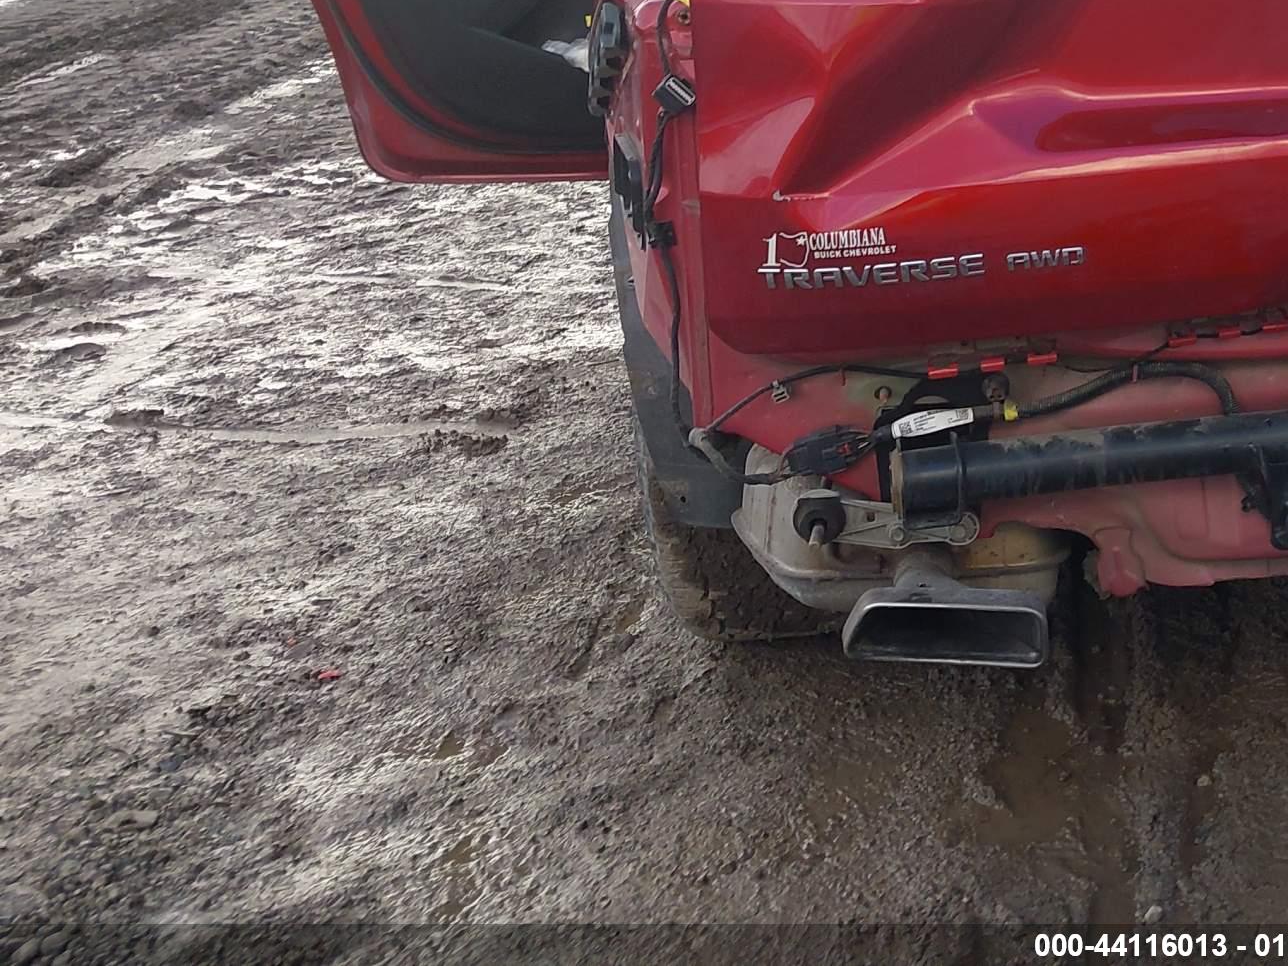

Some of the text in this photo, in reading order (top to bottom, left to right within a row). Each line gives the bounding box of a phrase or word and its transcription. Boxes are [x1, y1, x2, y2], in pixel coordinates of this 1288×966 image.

[809, 227, 886, 251] COLUMBIANA
[814, 245, 897, 259] BUICK CHEVROLET
[757, 246, 1084, 289] TRAVERSE AWD
